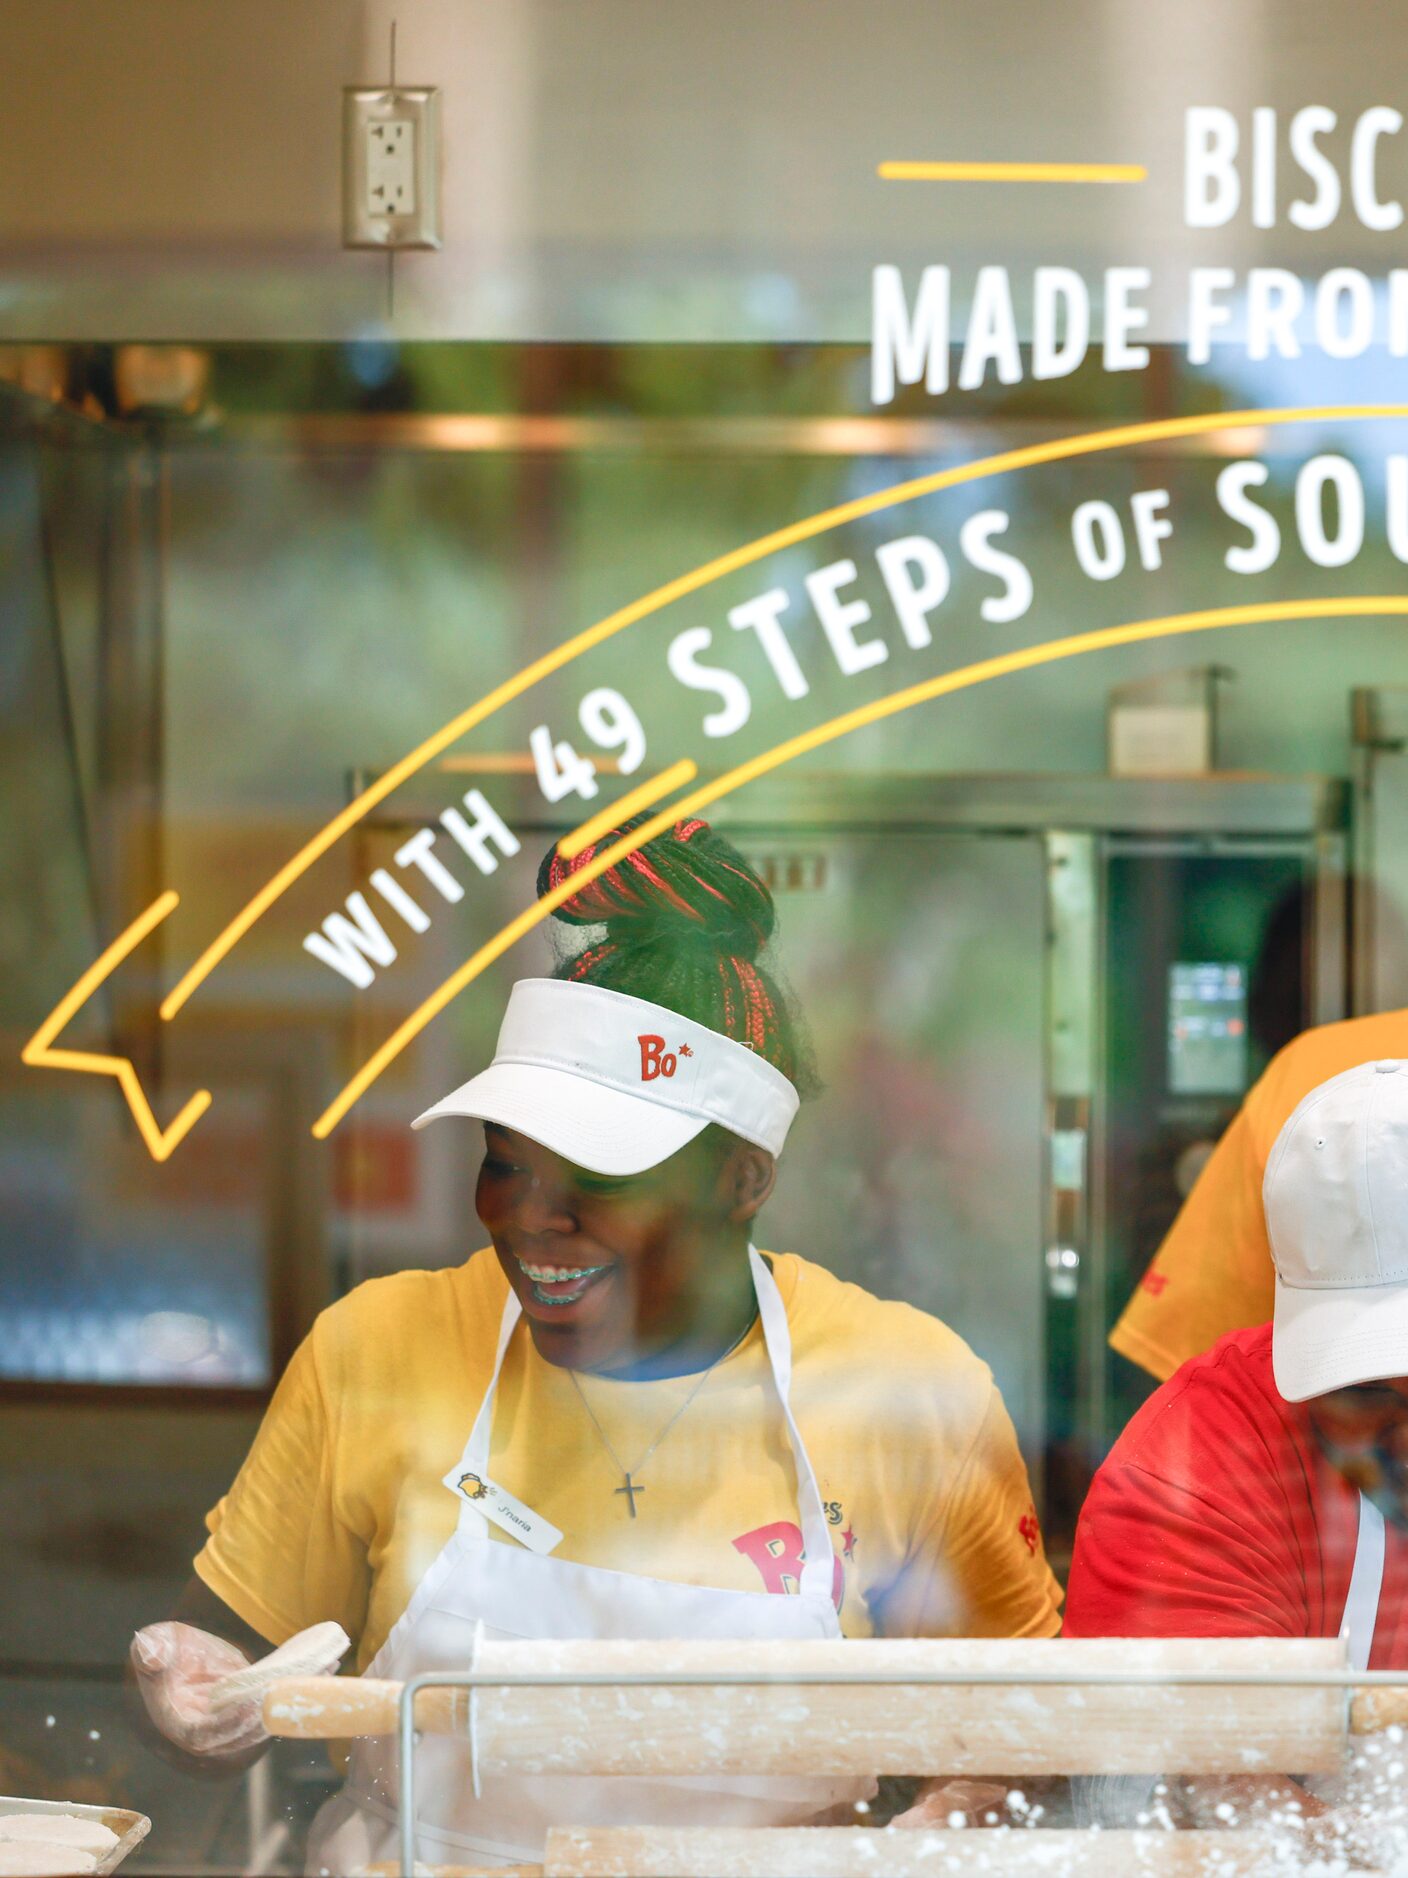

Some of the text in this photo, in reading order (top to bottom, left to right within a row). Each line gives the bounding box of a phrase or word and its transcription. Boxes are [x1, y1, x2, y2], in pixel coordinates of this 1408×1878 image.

[871, 264, 1151, 405] MADE
[302, 789, 521, 990] WITH
[529, 688, 647, 803] 49
[666, 510, 1034, 738] STEPS
[1072, 489, 1173, 581] OF
[637, 1034, 677, 1081] Bo
